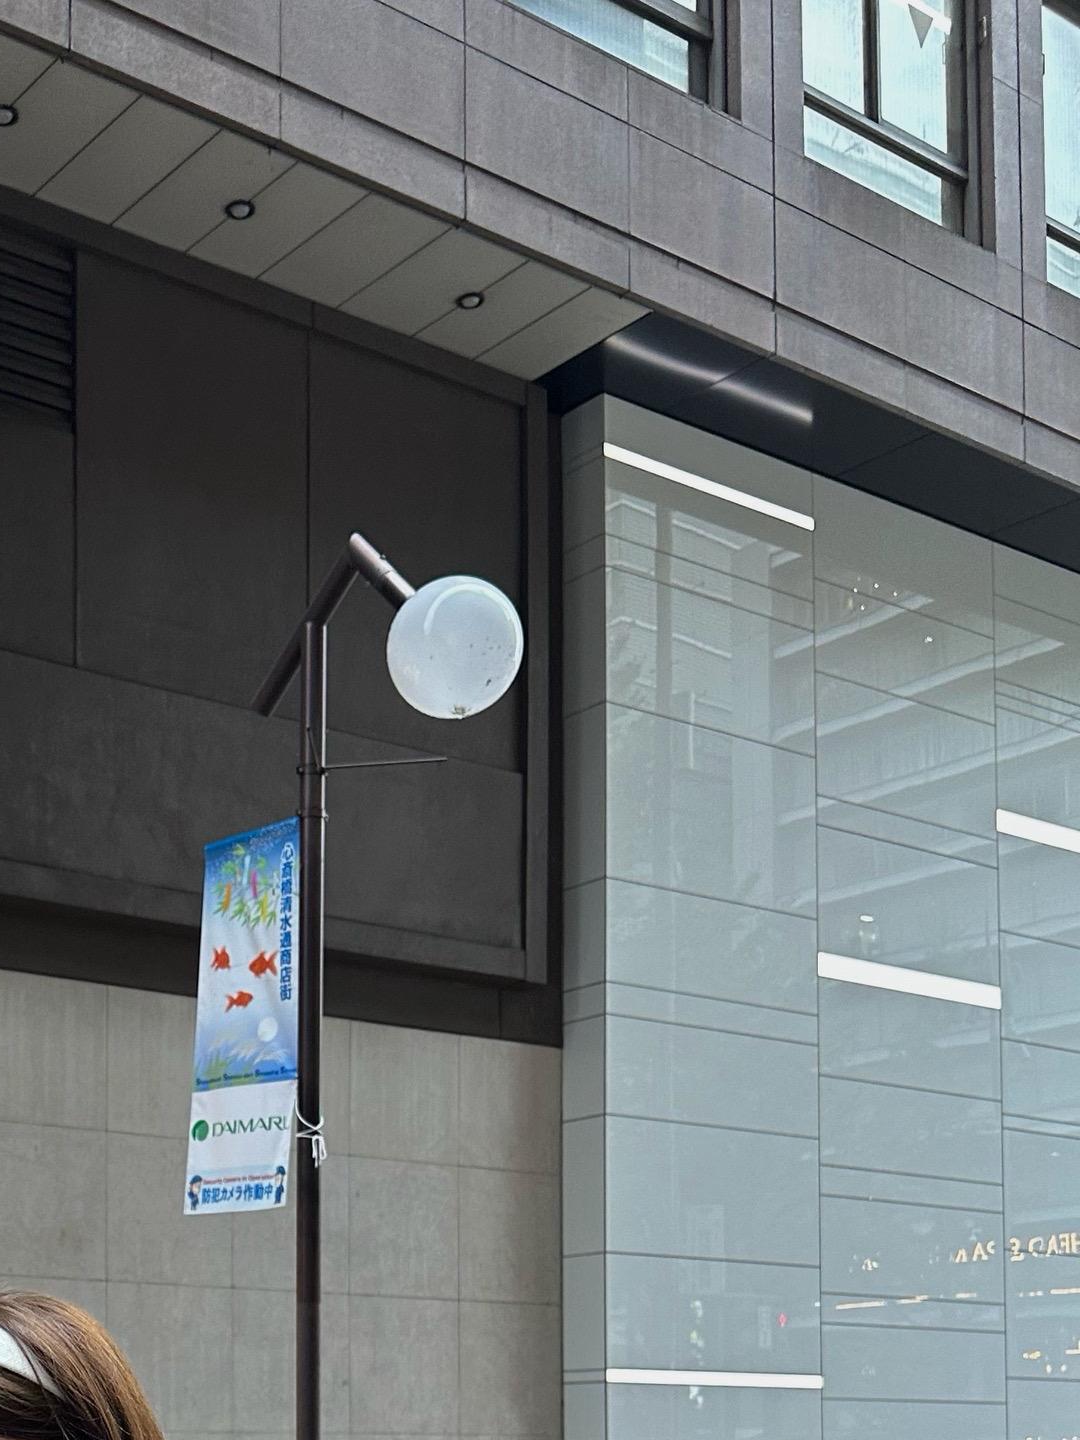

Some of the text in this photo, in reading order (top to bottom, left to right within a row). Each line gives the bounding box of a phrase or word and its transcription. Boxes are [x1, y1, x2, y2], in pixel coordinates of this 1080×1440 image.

[201, 1183, 273, 1204] 防犯カメラ作動中
